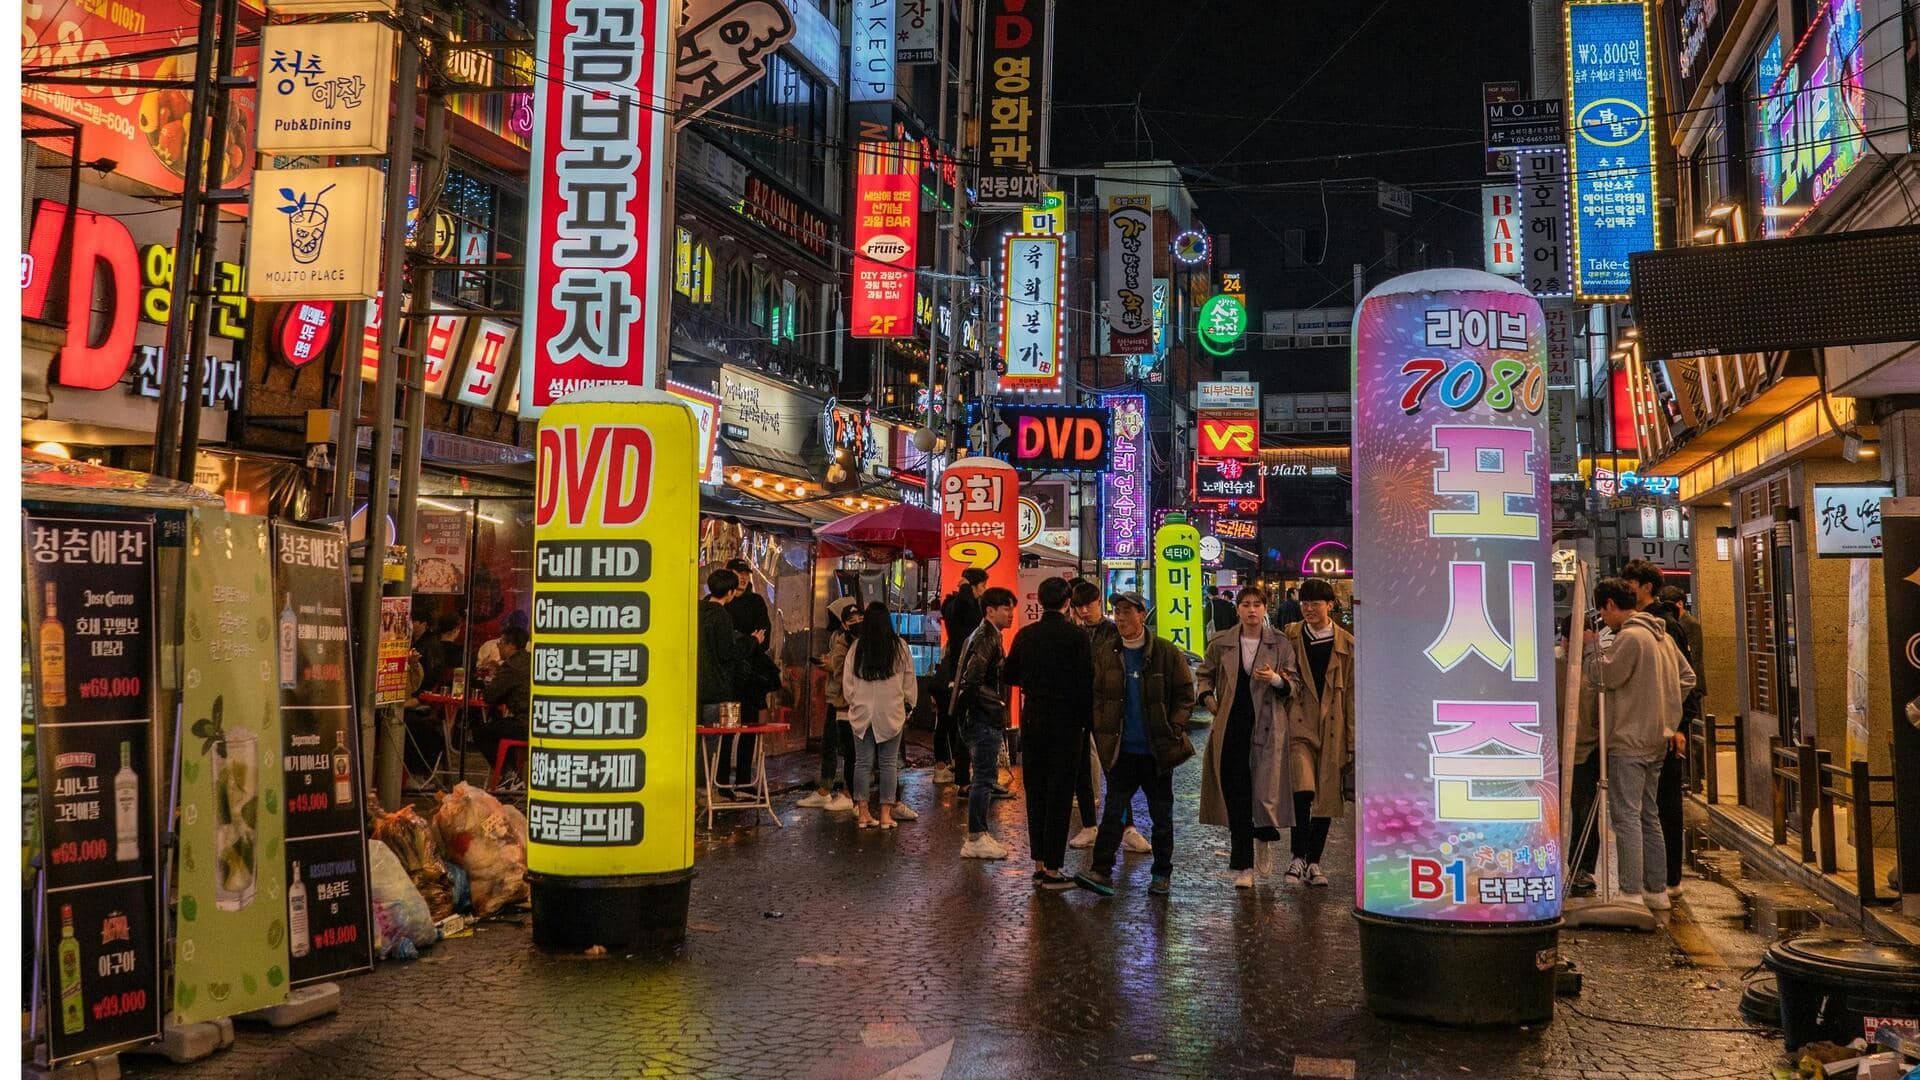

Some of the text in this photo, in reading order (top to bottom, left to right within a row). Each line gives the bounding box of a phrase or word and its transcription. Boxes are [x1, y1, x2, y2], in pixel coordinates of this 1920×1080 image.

[268, 50, 366, 109] 청춘 예찬
[274, 118, 351, 131] Pub&Dining
[990, 56, 1032, 167] 영화관
[555, 6, 637, 358] 꼼보포차
[980, 176, 1040, 199] 진동의자
[885, 215, 911, 227] BAR
[1492, 195, 1514, 264] BAR
[1530, 155, 1559, 272] 민호헤어
[867, 244, 905, 254] Fruits
[265, 269, 345, 282] MOJITO PLACE
[860, 271, 877, 280] DIY
[1223, 280, 1241, 292] 24
[1532, 278, 1561, 292] 2층
[868, 315, 898, 335] 2F
[1424, 308, 1529, 352] 라이브
[138, 345, 242, 411] 진의자
[1400, 357, 1546, 415] 7080
[1017, 415, 1103, 461] DVD
[1203, 424, 1256, 452] VR
[537, 427, 653, 526] DVD
[1202, 480, 1255, 494] 노래연습장
[944, 474, 1004, 521] 육회
[32, 528, 147, 566] 청춘예찬
[280, 533, 341, 570] 청춘예찬
[537, 547, 640, 577] Full HD
[75, 617, 100, 635] 호세
[535, 598, 642, 630] Cinema
[1167, 566, 1192, 652] 마사지
[1422, 424, 1544, 822] 포시즌
[534, 648, 639, 682] 대형스크린
[532, 700, 637, 735] 진동의자
[54, 776, 99, 797] 스미노프
[531, 752, 637, 788] 영화+팝콘+커피
[530, 804, 634, 842] 무료셀프바
[1408, 856, 1557, 905] B1 단란주점
[98, 950, 136, 977] 아구아
